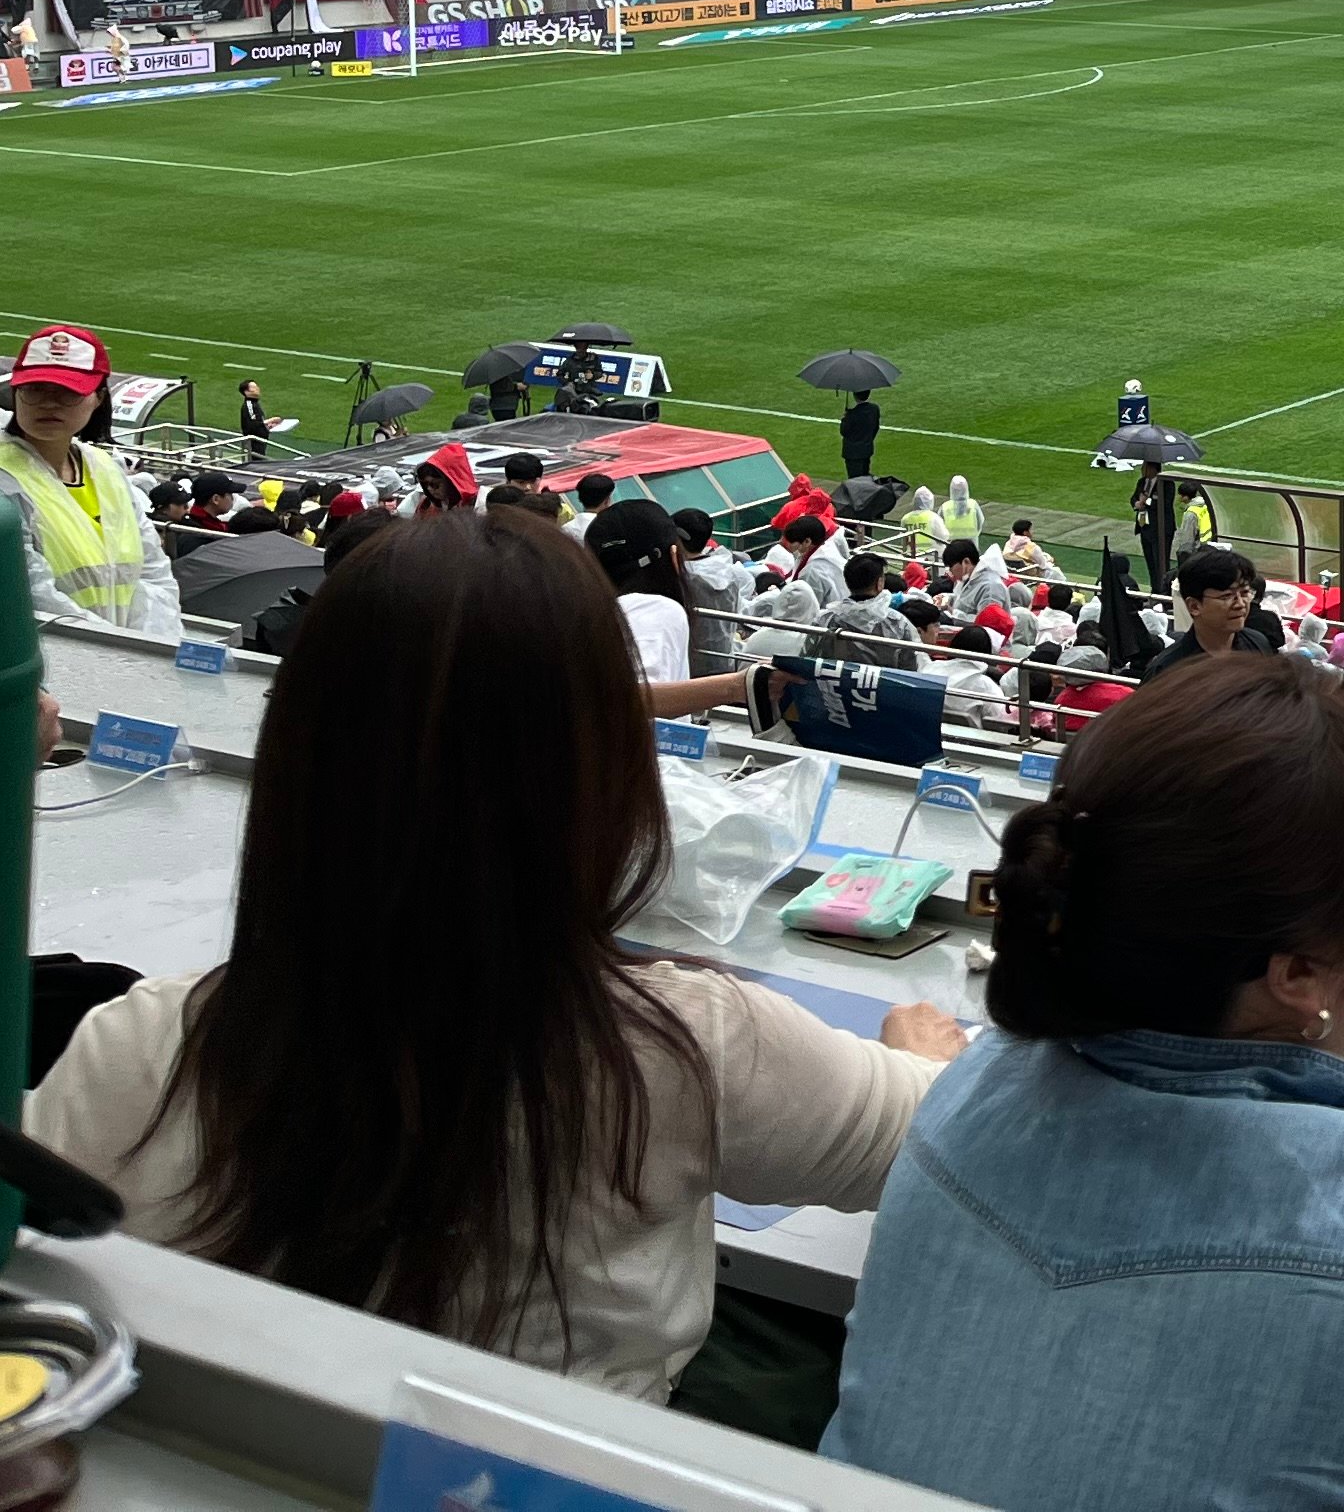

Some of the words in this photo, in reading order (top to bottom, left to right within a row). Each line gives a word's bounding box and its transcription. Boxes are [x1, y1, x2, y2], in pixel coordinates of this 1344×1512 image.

[428, 1, 466, 22] GS
[251, 43, 312, 62] coupang
[314, 38, 343, 57] play
[568, 28, 602, 51] Pay
[145, 54, 193, 70] 아카데미
